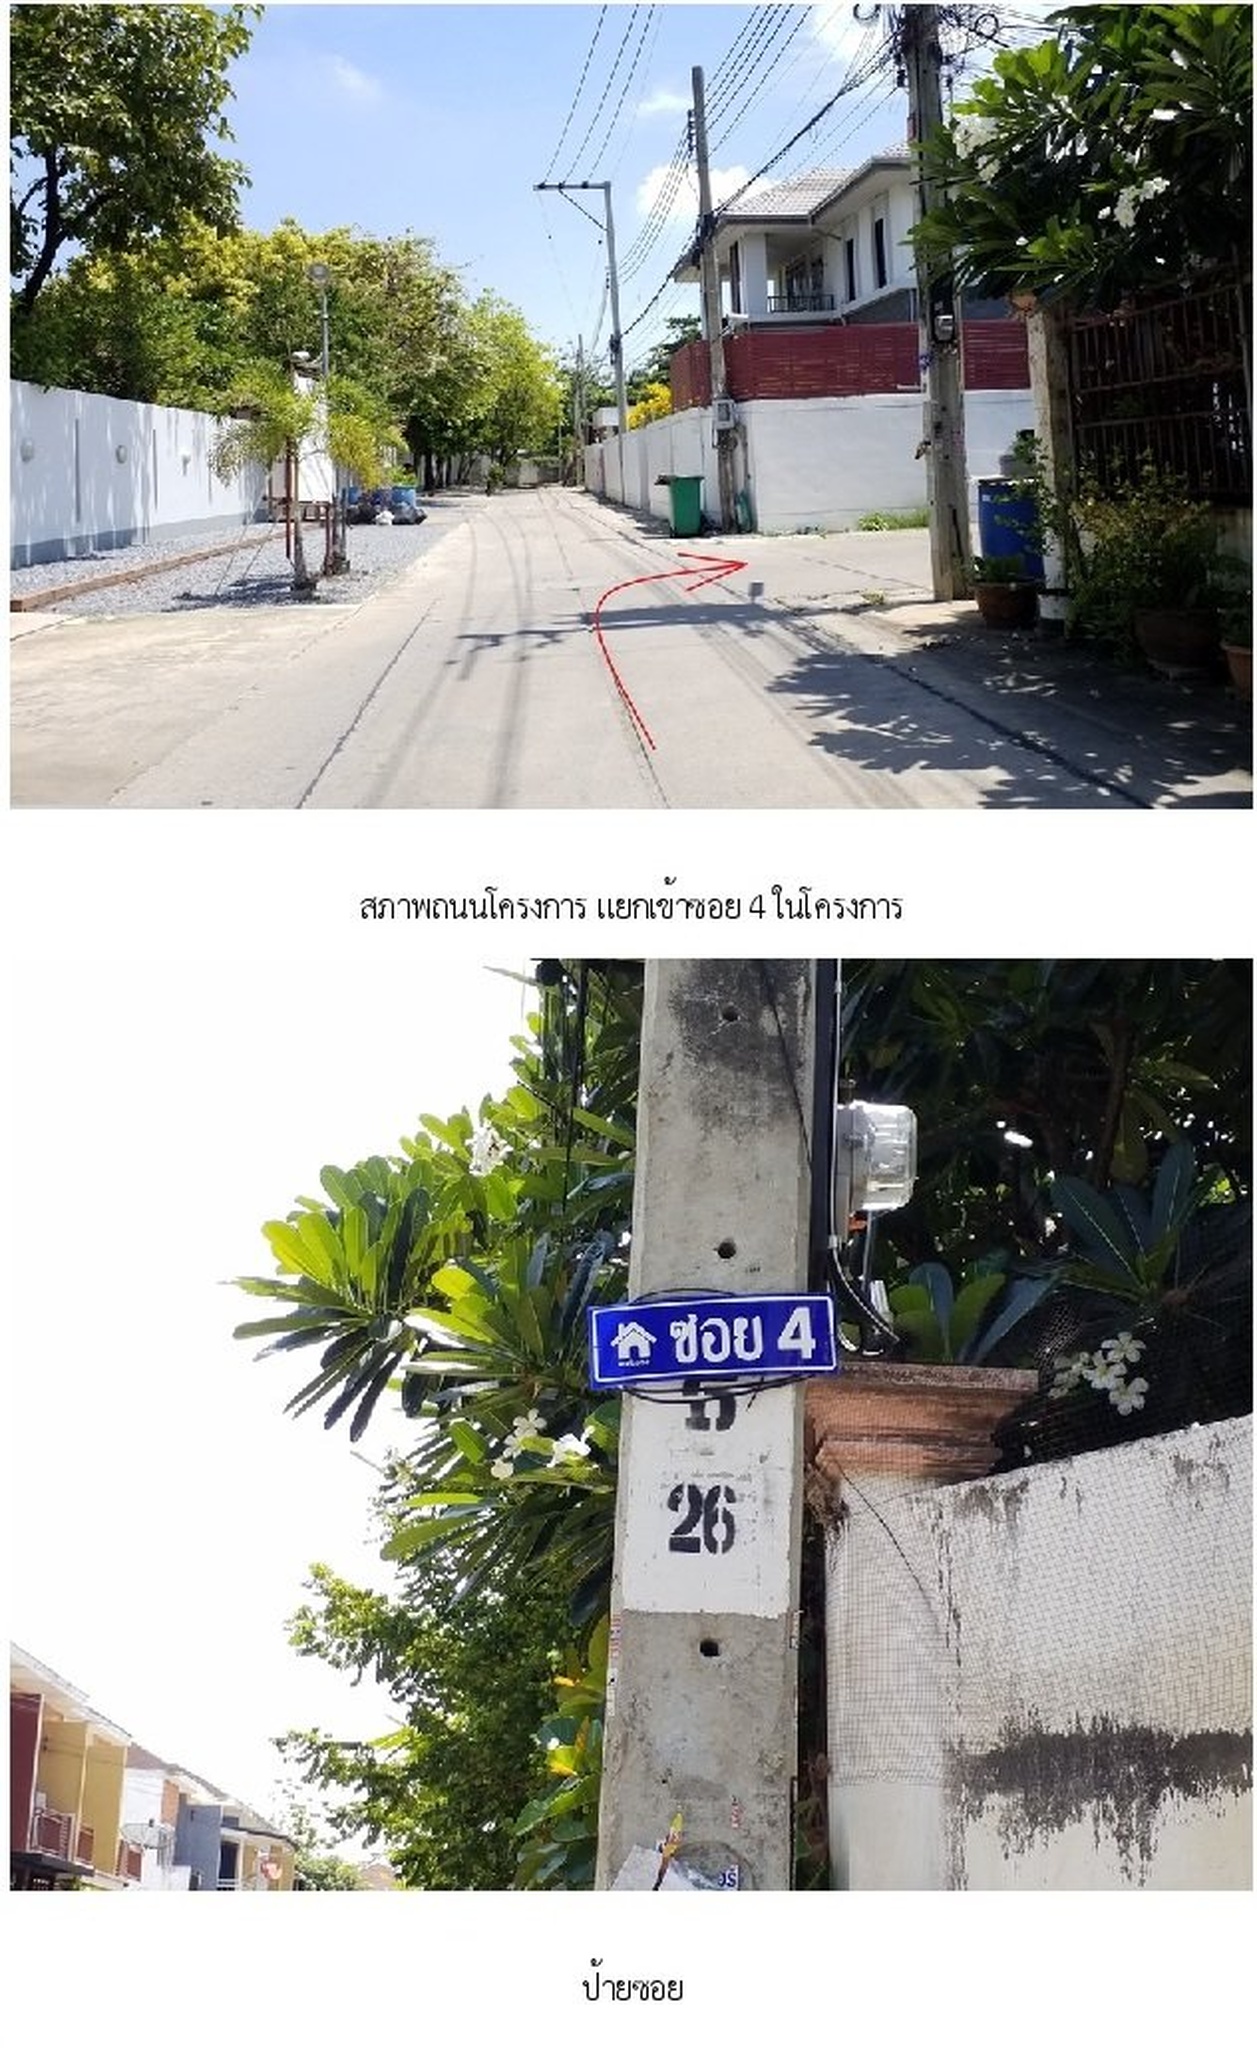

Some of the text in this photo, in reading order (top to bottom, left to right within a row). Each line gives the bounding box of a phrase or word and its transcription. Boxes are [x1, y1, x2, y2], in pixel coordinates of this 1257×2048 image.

[669, 1306, 817, 1364] ซอย 4
[667, 1483, 737, 1555] 26
